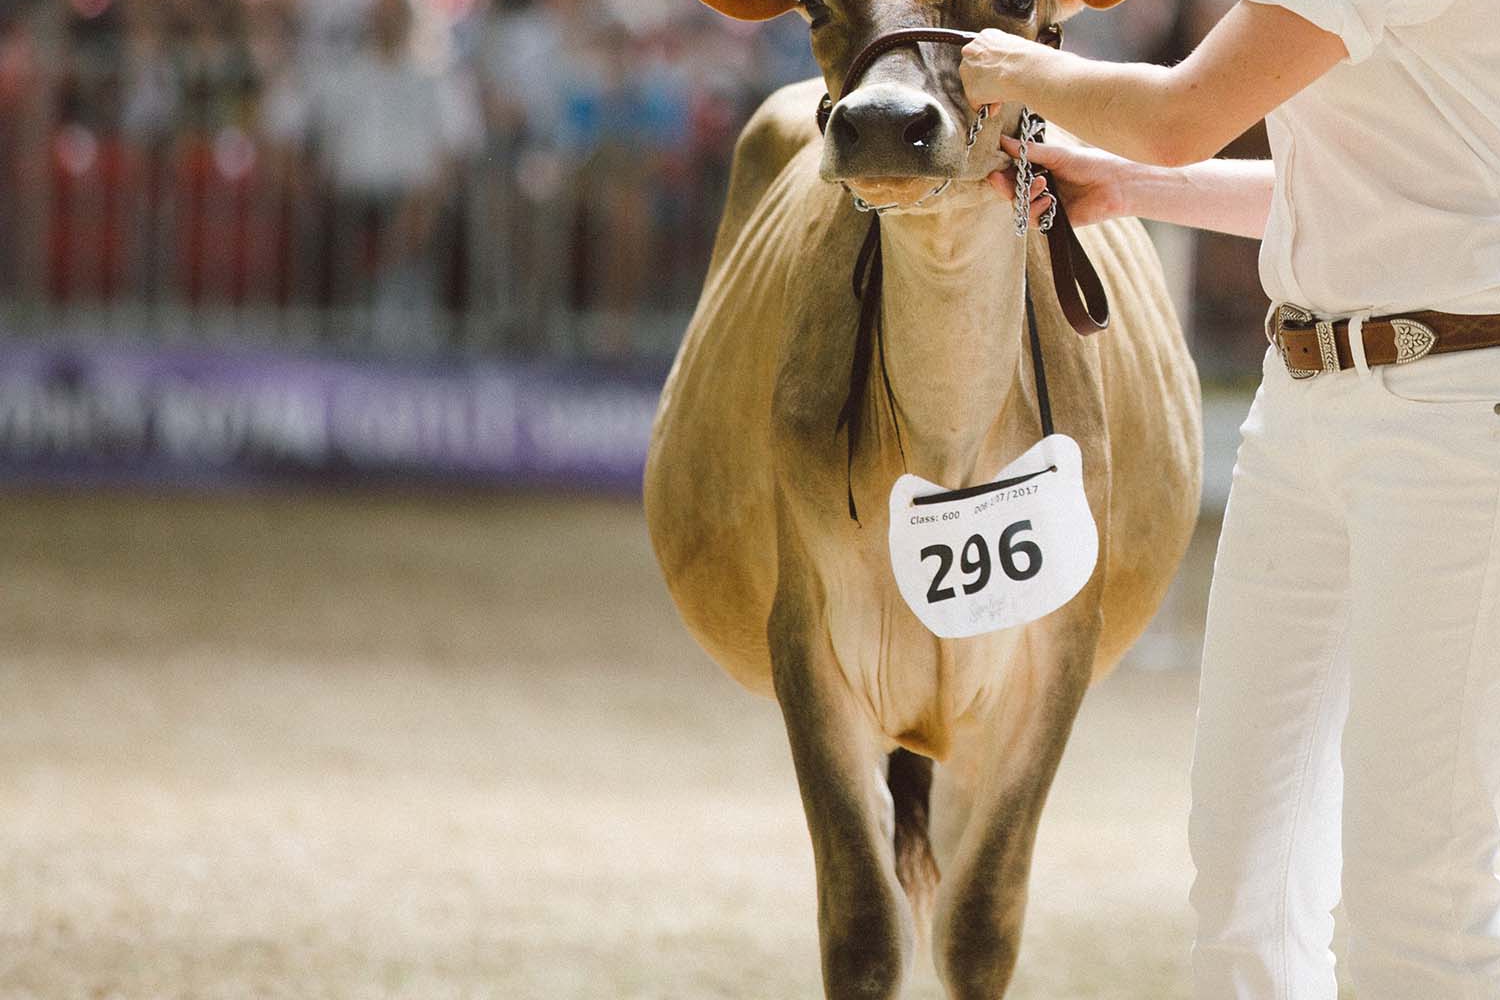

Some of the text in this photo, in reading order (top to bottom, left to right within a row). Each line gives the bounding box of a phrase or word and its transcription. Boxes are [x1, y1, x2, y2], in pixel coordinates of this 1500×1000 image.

[910, 515, 939, 525] Class:
[942, 510, 960, 521] 600
[920, 519, 1043, 604] 296
